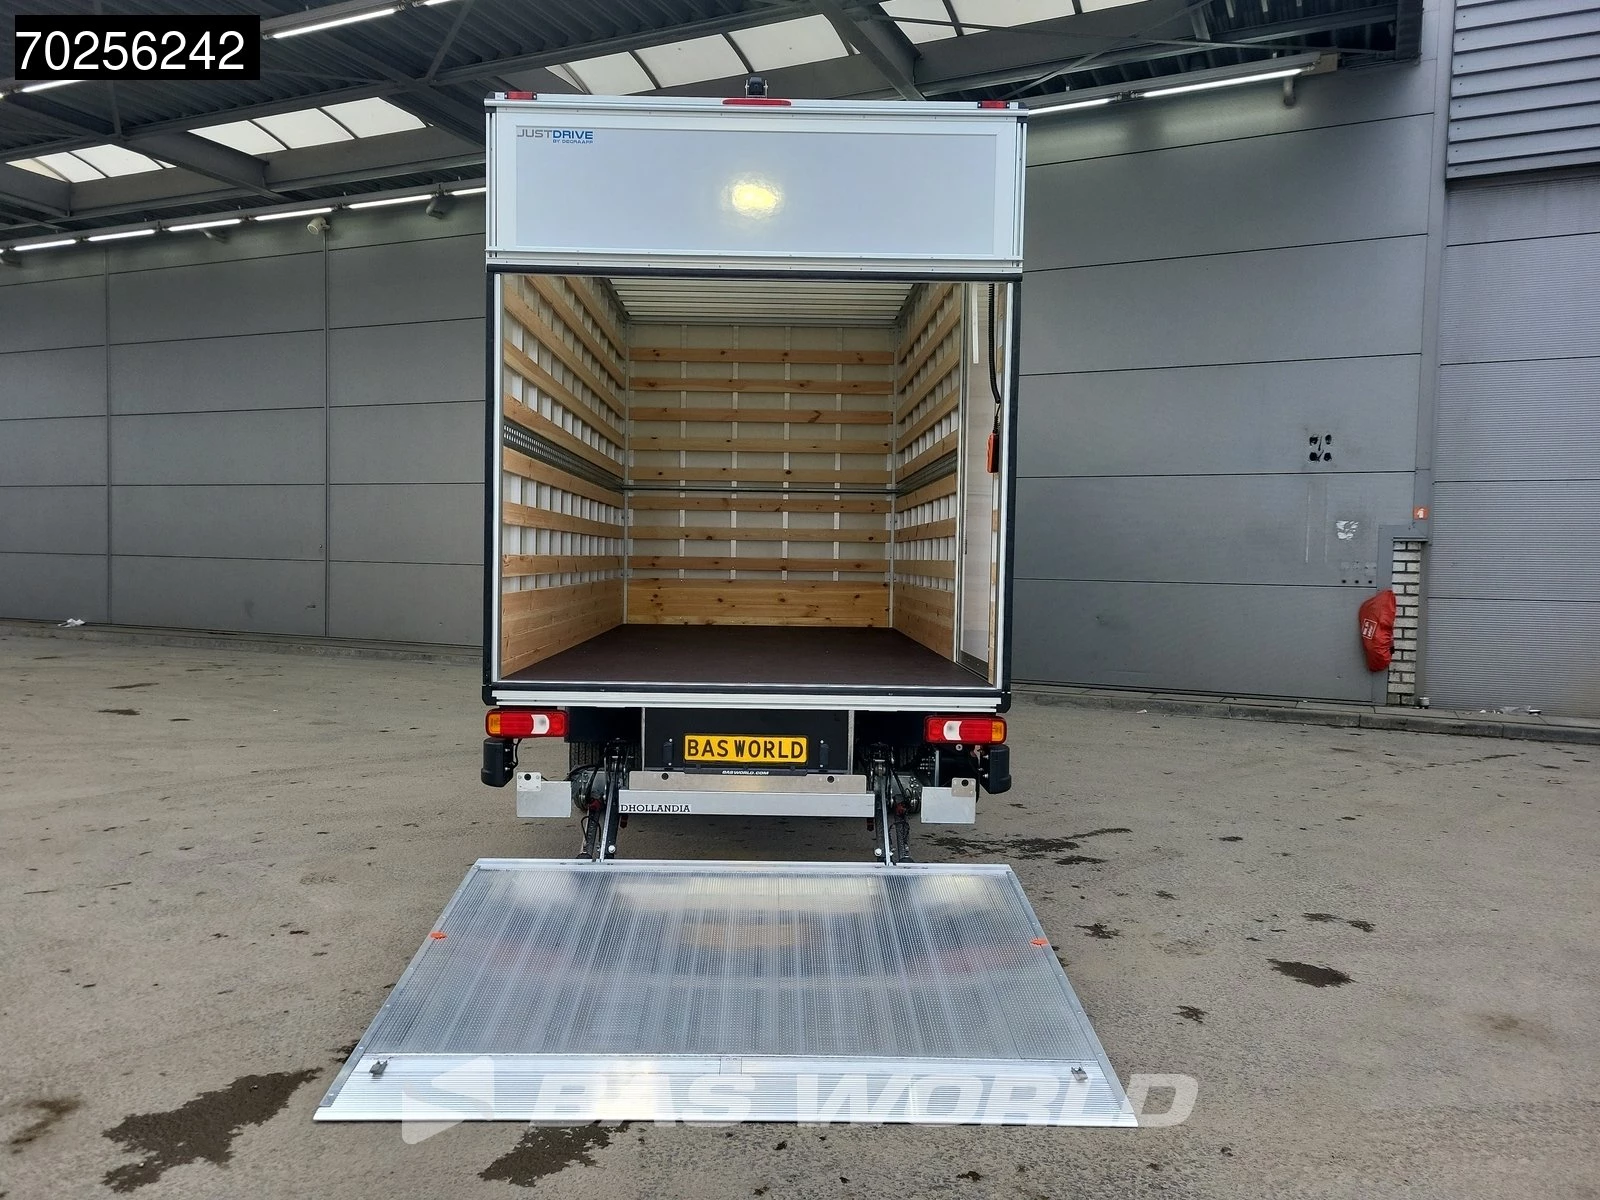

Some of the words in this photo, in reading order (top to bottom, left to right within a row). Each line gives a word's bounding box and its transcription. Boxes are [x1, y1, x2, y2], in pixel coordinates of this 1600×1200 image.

[516, 129, 594, 139] JUSTDRIVE
[687, 739, 729, 758] BAS
[733, 739, 804, 759] WORLD
[620, 804, 691, 813] DHOLLANDIA
